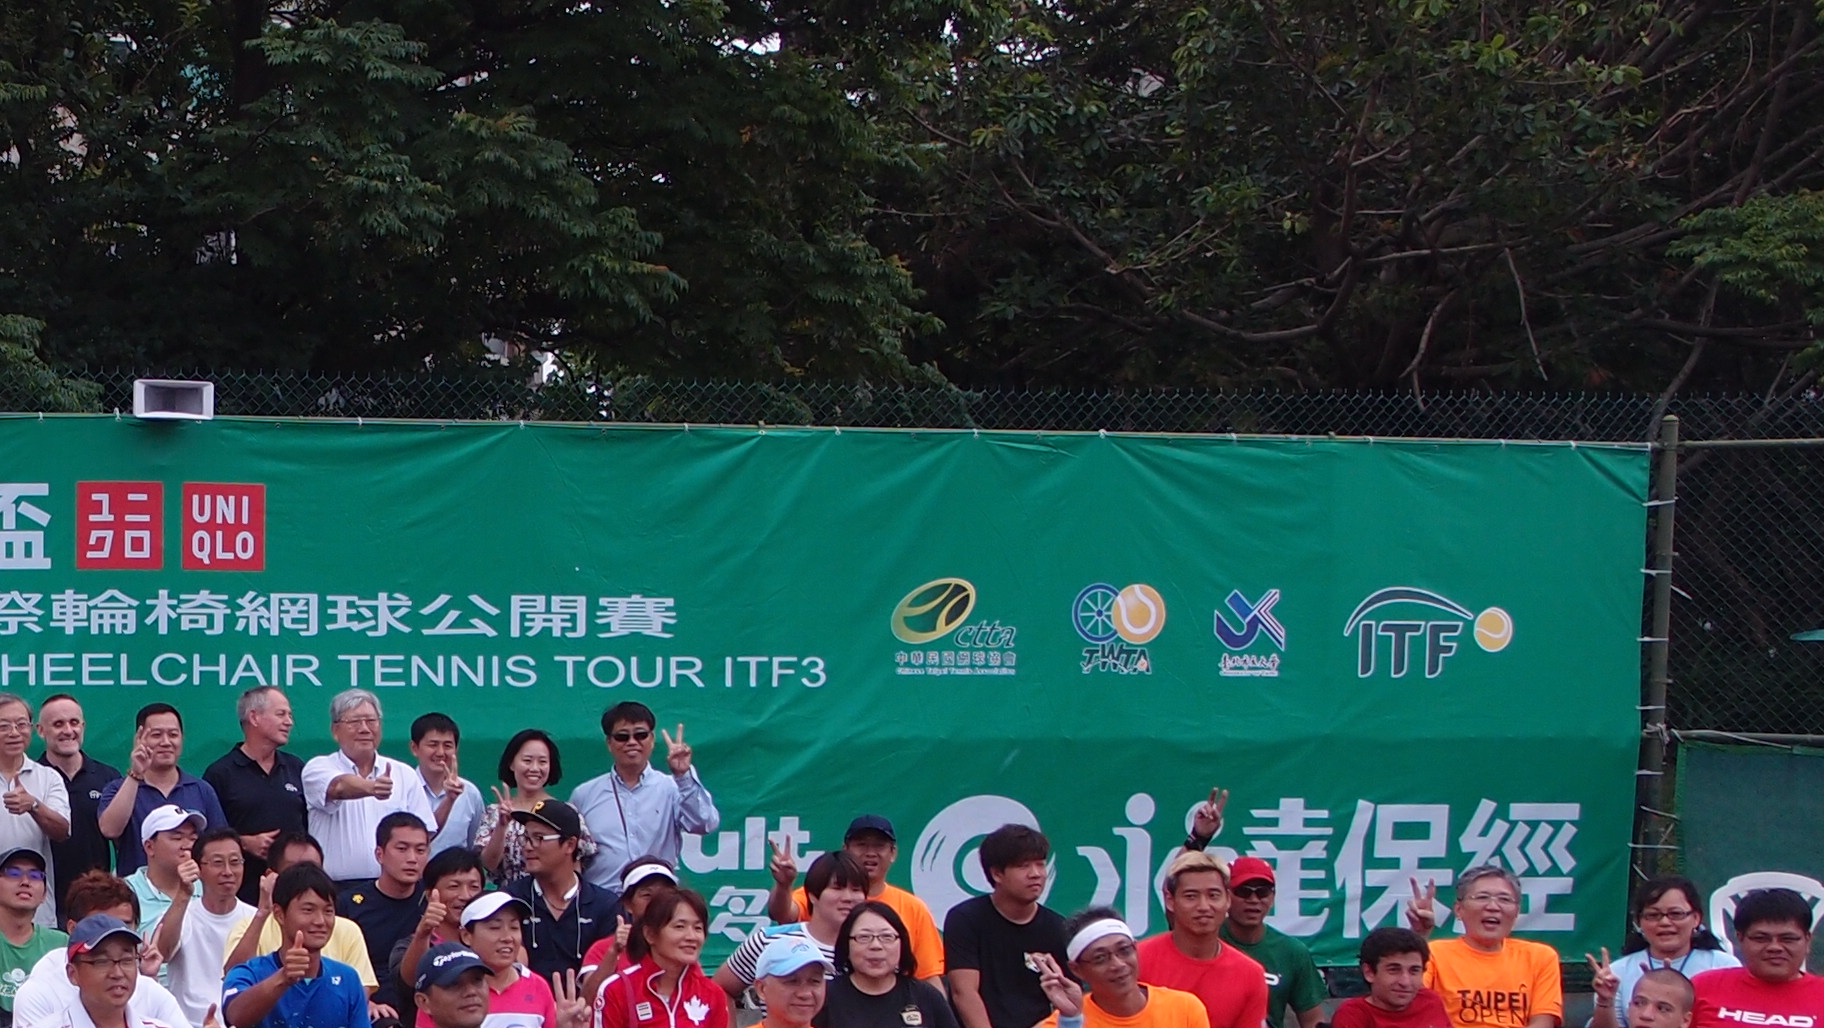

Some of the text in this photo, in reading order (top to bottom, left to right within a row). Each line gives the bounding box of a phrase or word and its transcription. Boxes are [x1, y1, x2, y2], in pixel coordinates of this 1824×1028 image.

[192, 494, 249, 524] UNI
[192, 530, 254, 564] QLO
[1358, 621, 1463, 678] ITF
[336, 653, 537, 688] TENNIS
[554, 654, 704, 688] TOUR
[725, 655, 826, 688] ITF3
[1457, 989, 1528, 1010] TAIPEI
[1459, 1005, 1529, 1027] OPEN
[1717, 1006, 1815, 1028] HEAD
